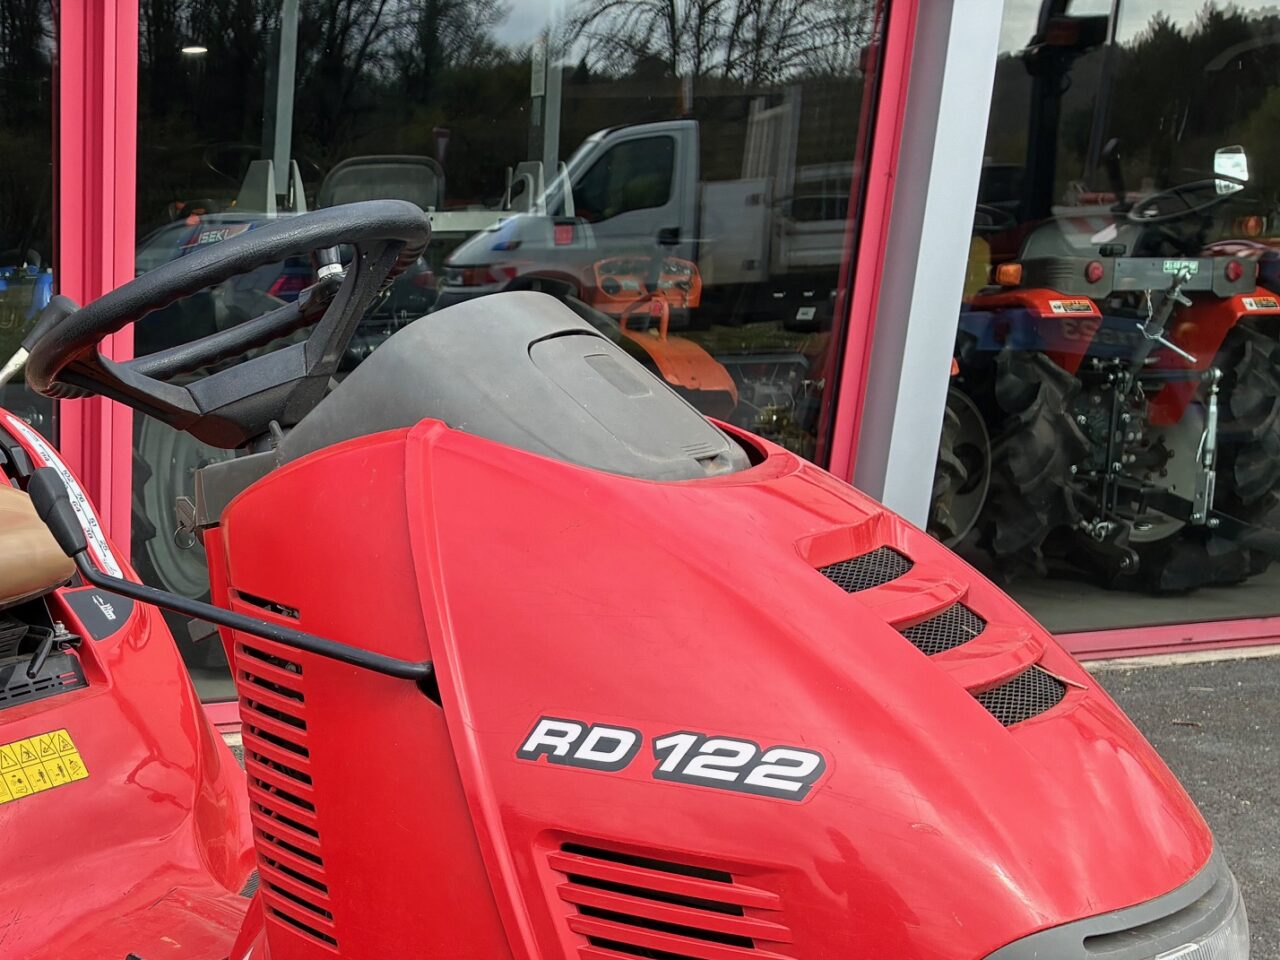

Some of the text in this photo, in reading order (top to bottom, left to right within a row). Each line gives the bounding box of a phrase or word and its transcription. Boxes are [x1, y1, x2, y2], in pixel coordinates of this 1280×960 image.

[199, 229, 229, 244] ISEKI
[72, 501, 81, 512] 64
[518, 717, 824, 797] RD 122
